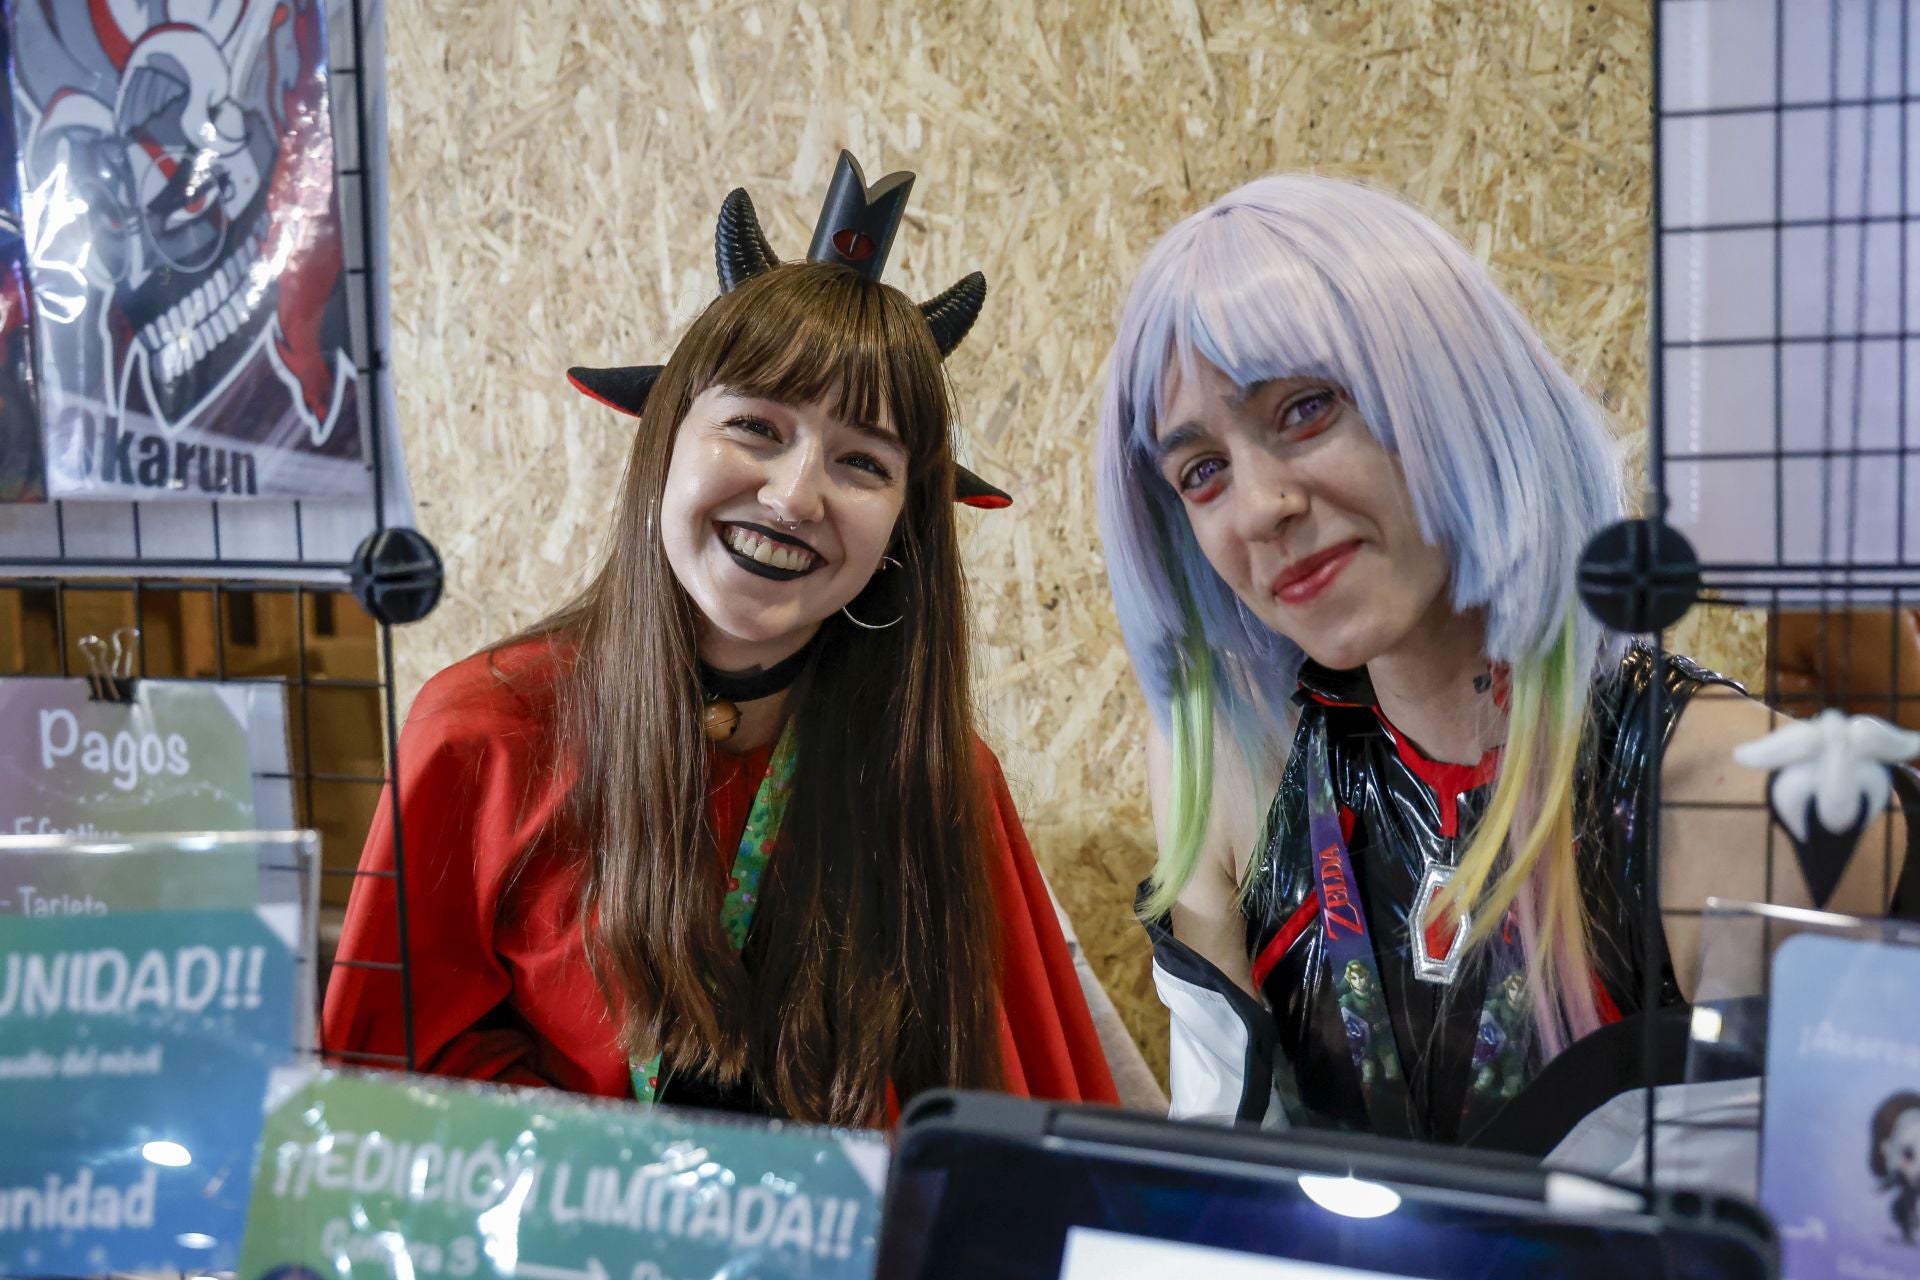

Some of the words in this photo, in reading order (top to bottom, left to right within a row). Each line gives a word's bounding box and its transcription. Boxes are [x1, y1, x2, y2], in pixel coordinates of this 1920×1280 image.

[57, 406, 257, 495] Okarun
[39, 708, 190, 791] Pagos
[1319, 842, 1363, 940] ZELDA
[551, 1161, 860, 1260] LIMITADA!!
